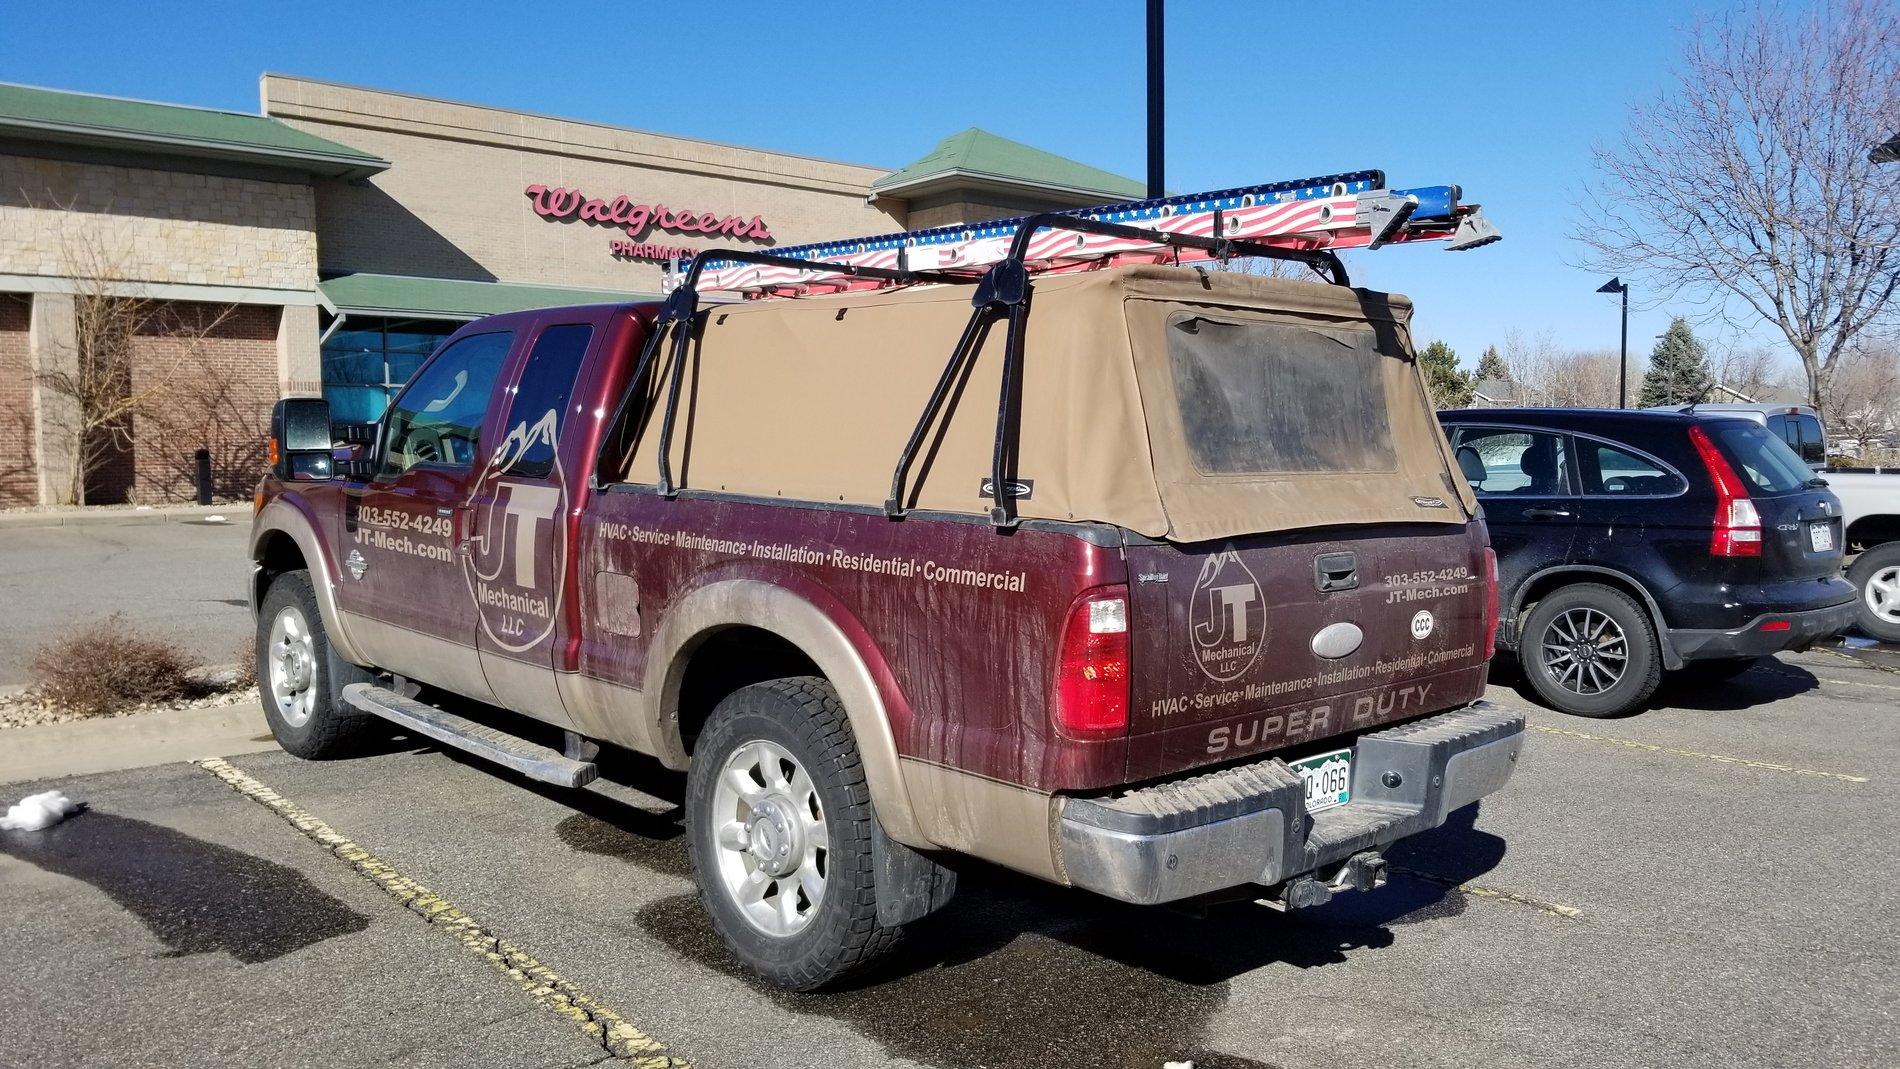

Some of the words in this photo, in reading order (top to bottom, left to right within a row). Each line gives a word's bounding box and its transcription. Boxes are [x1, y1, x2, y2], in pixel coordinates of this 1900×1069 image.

[526, 184, 771, 239] Walgreens
[356, 505, 453, 538] 303-552-4249
[470, 482, 560, 589] JT
[354, 527, 453, 563] JT-Mech.com
[1384, 566, 1468, 588] 303-552-4249
[477, 582, 550, 619] Mechanical
[1385, 584, 1468, 604] JT-Mech.com
[501, 614, 525, 637] LLC
[1195, 583, 1256, 647] JT
[1414, 617, 1430, 632] CCC
[1202, 641, 1255, 662] Mechanical
[1220, 661, 1237, 673] LLC
[1206, 705, 1330, 754] SUPER
[1352, 682, 1432, 721] DUTY
[1305, 766, 1346, 800] Q-066
